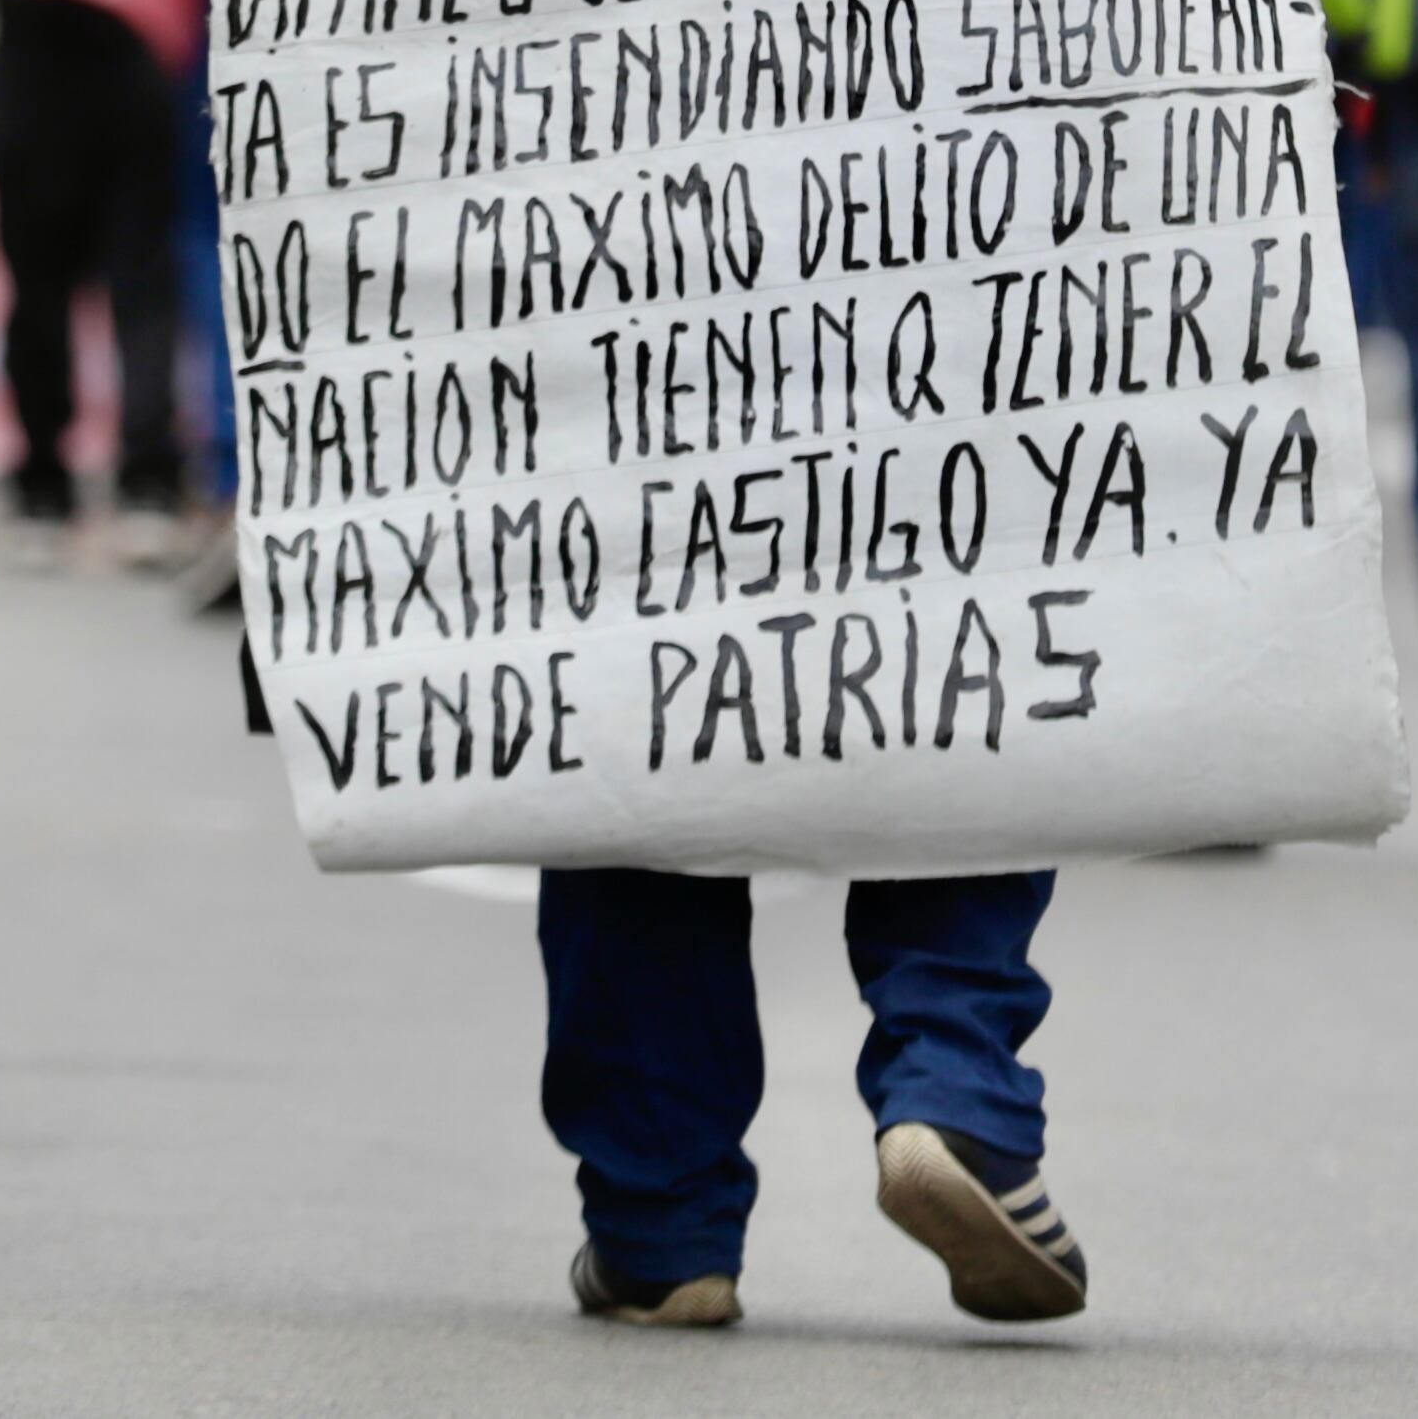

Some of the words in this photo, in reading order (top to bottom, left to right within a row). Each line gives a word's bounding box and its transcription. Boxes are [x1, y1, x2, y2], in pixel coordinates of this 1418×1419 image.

[217, 79, 289, 205] TA
[325, 62, 406, 188] ES
[233, 219, 311, 360] DO
[345, 206, 413, 344] EL
[1052, 110, 1131, 247] DE
[1161, 104, 1307, 224] UNA
[886, 290, 945, 421] Q
[972, 248, 1213, 415] TENER
[1242, 232, 1320, 383] EL
[1199, 404, 1319, 541] YA
[294, 652, 584, 793] VENDE
